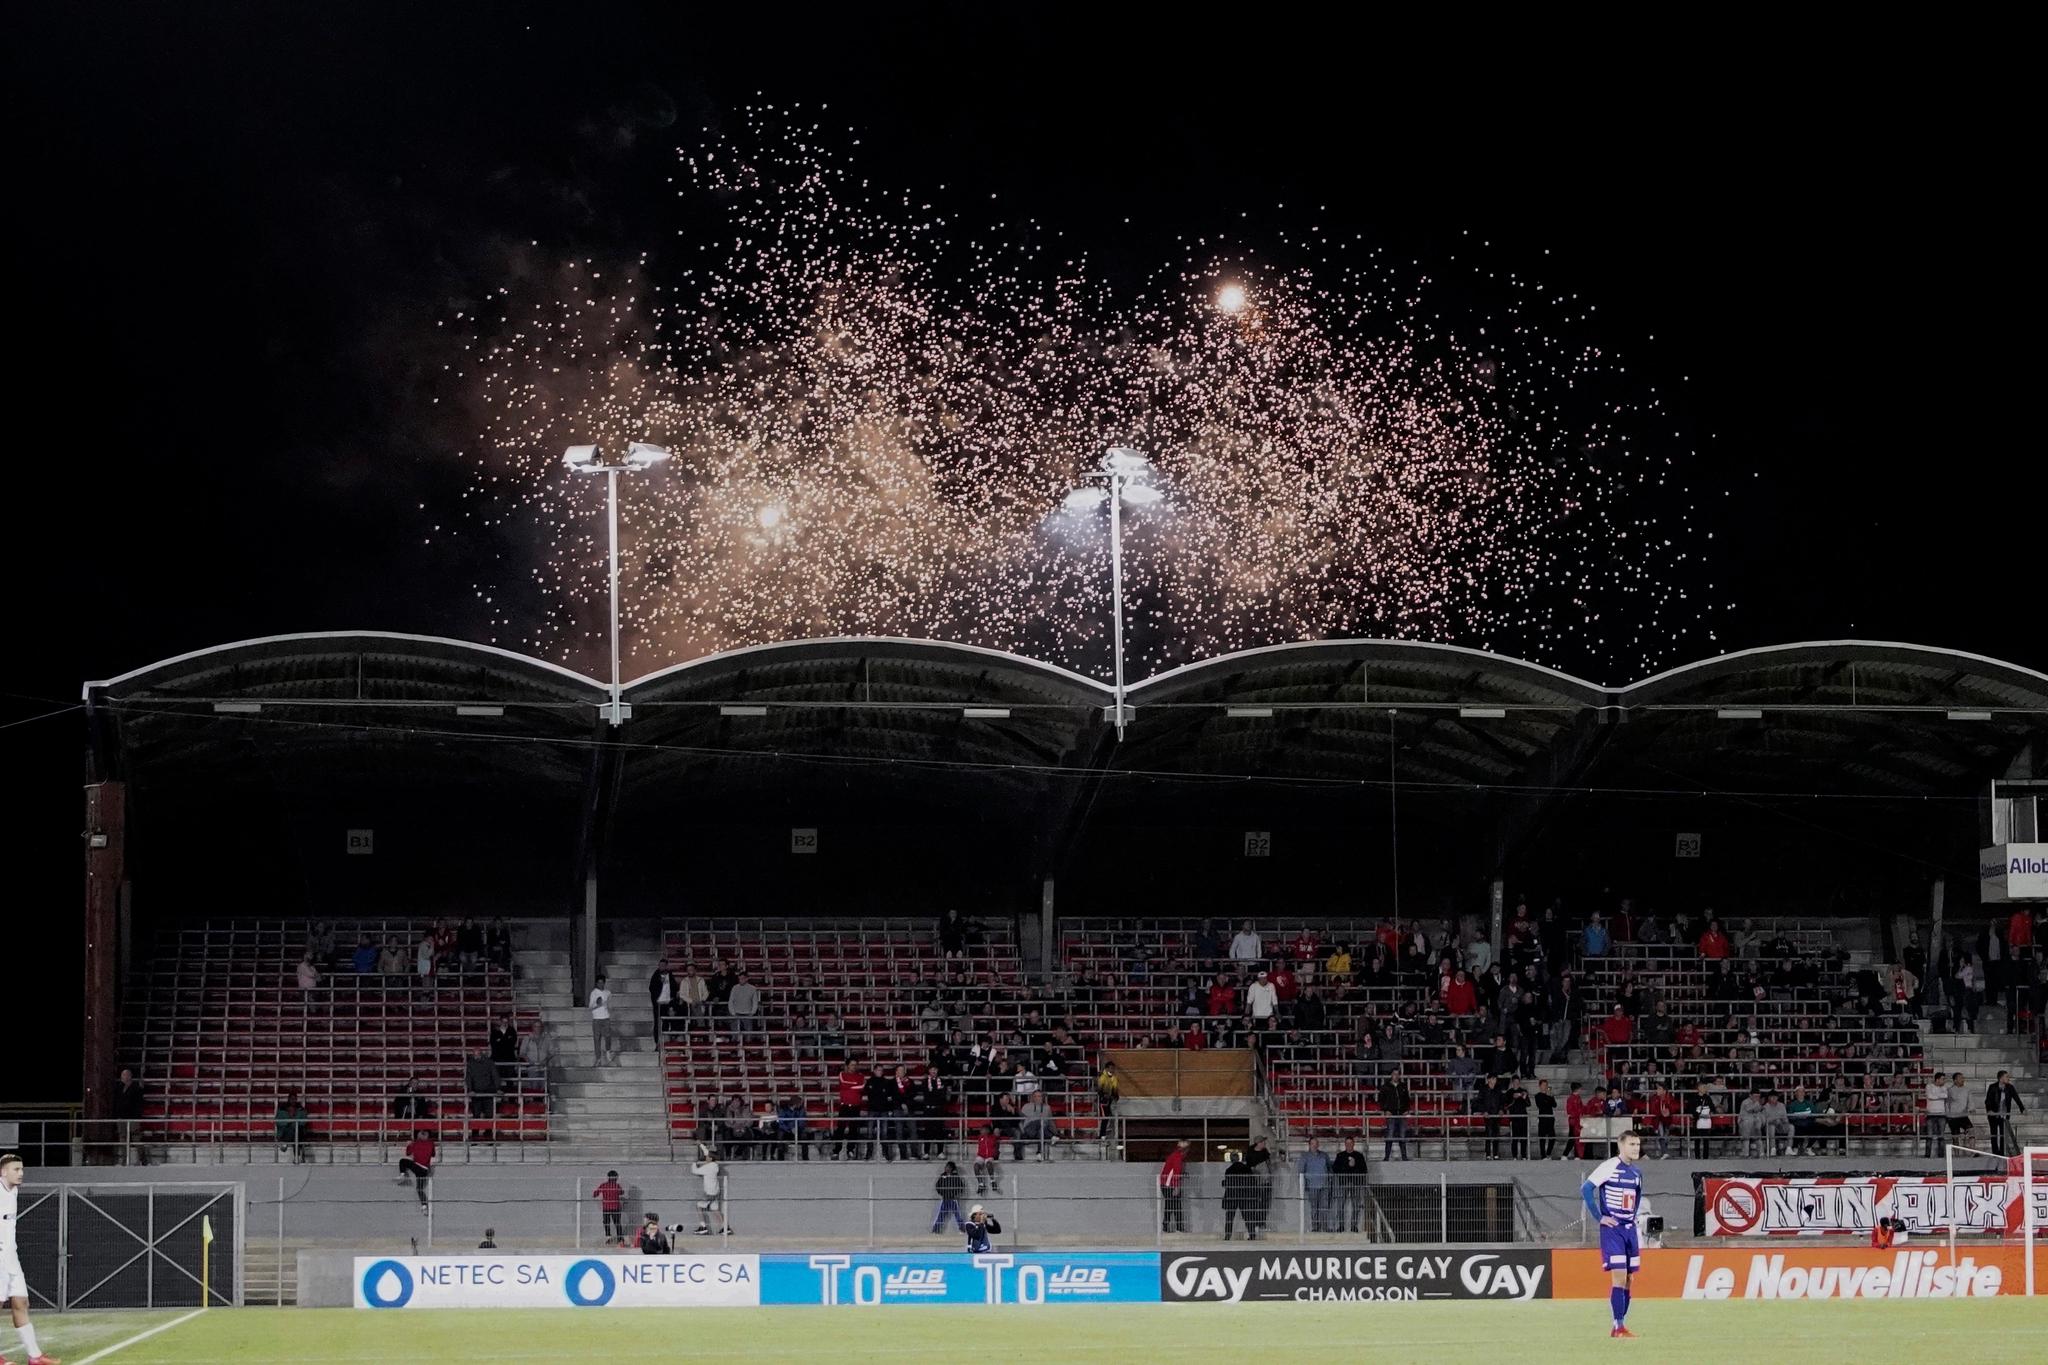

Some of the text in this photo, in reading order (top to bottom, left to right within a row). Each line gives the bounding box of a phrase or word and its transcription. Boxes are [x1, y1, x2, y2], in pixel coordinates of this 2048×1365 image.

[794, 835, 816, 847] B2
[1248, 838, 1269, 849] B2
[1761, 1184, 1877, 1230] NON
[1893, 1184, 2008, 1230] AUX
[420, 1264, 549, 1285] NETEC SA
[622, 1263, 751, 1284] NETEC SA
[1258, 1256, 1453, 1280] MAURICE GAY
[1682, 1250, 2003, 1299] Le Nouvelliste
[1295, 1287, 1418, 1301] CHAMOSON
